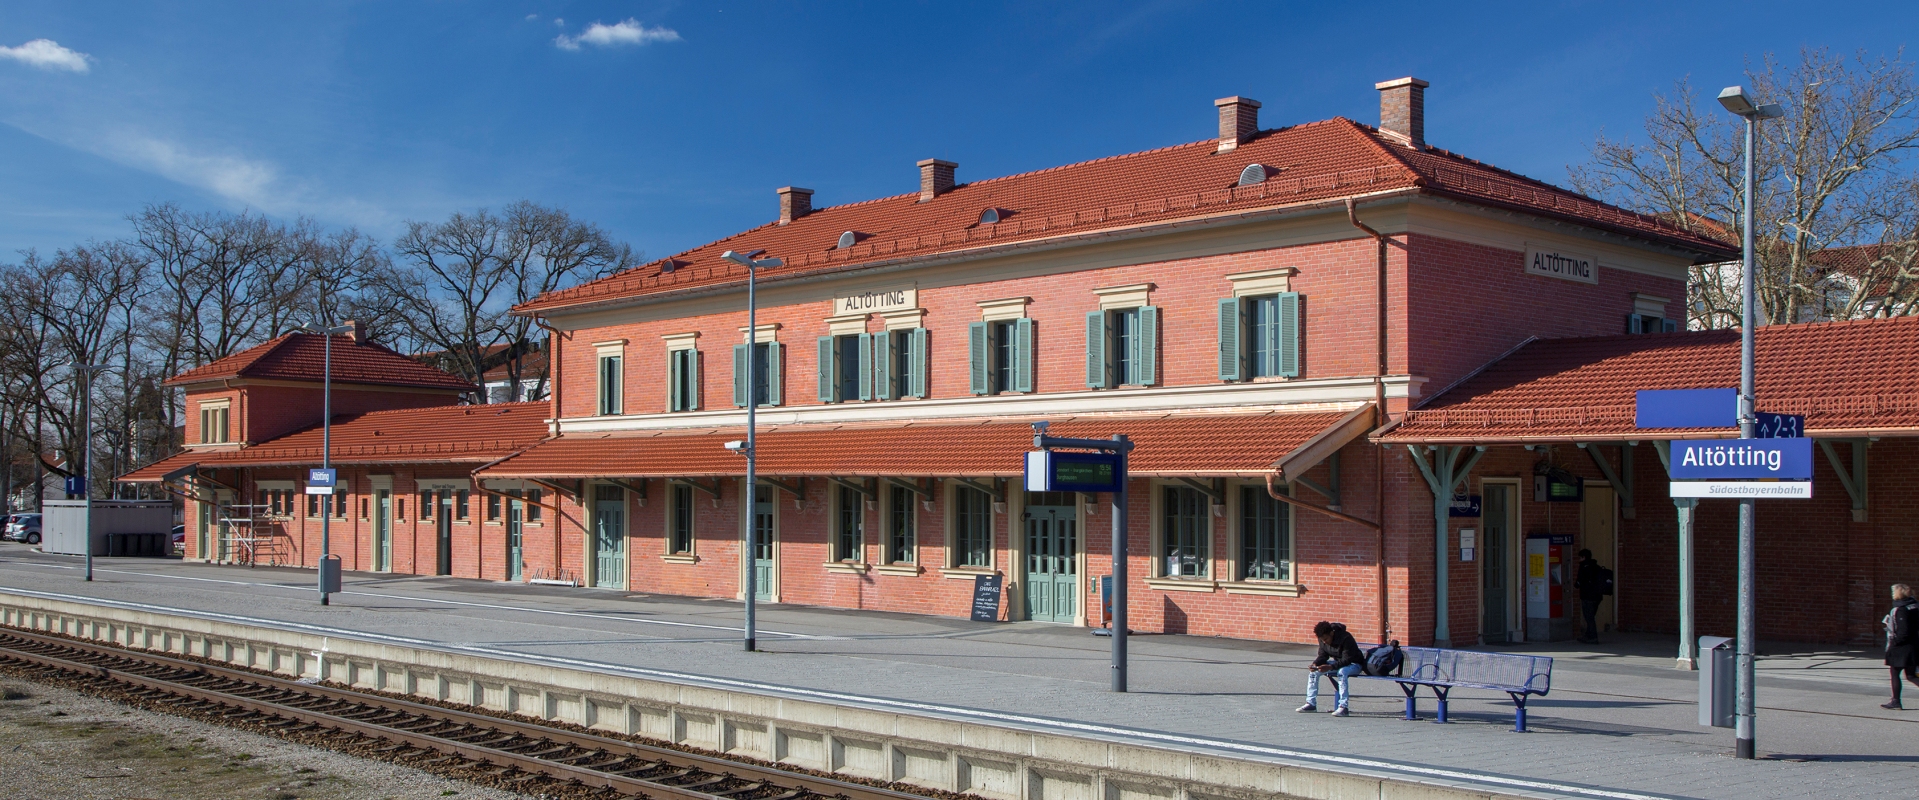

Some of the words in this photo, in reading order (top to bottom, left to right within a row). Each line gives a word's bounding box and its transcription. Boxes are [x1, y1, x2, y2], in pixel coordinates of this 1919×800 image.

[1533, 252, 1590, 278] ALTÖTTING
[845, 290, 905, 311] ALTÖTTING
[1773, 415, 1797, 438] 2-3
[1681, 446, 1782, 471] Altötting
[68, 477, 75, 490] 1
[312, 471, 330, 483] Altötting
[1709, 485, 1804, 496] Südostbayernbahn
